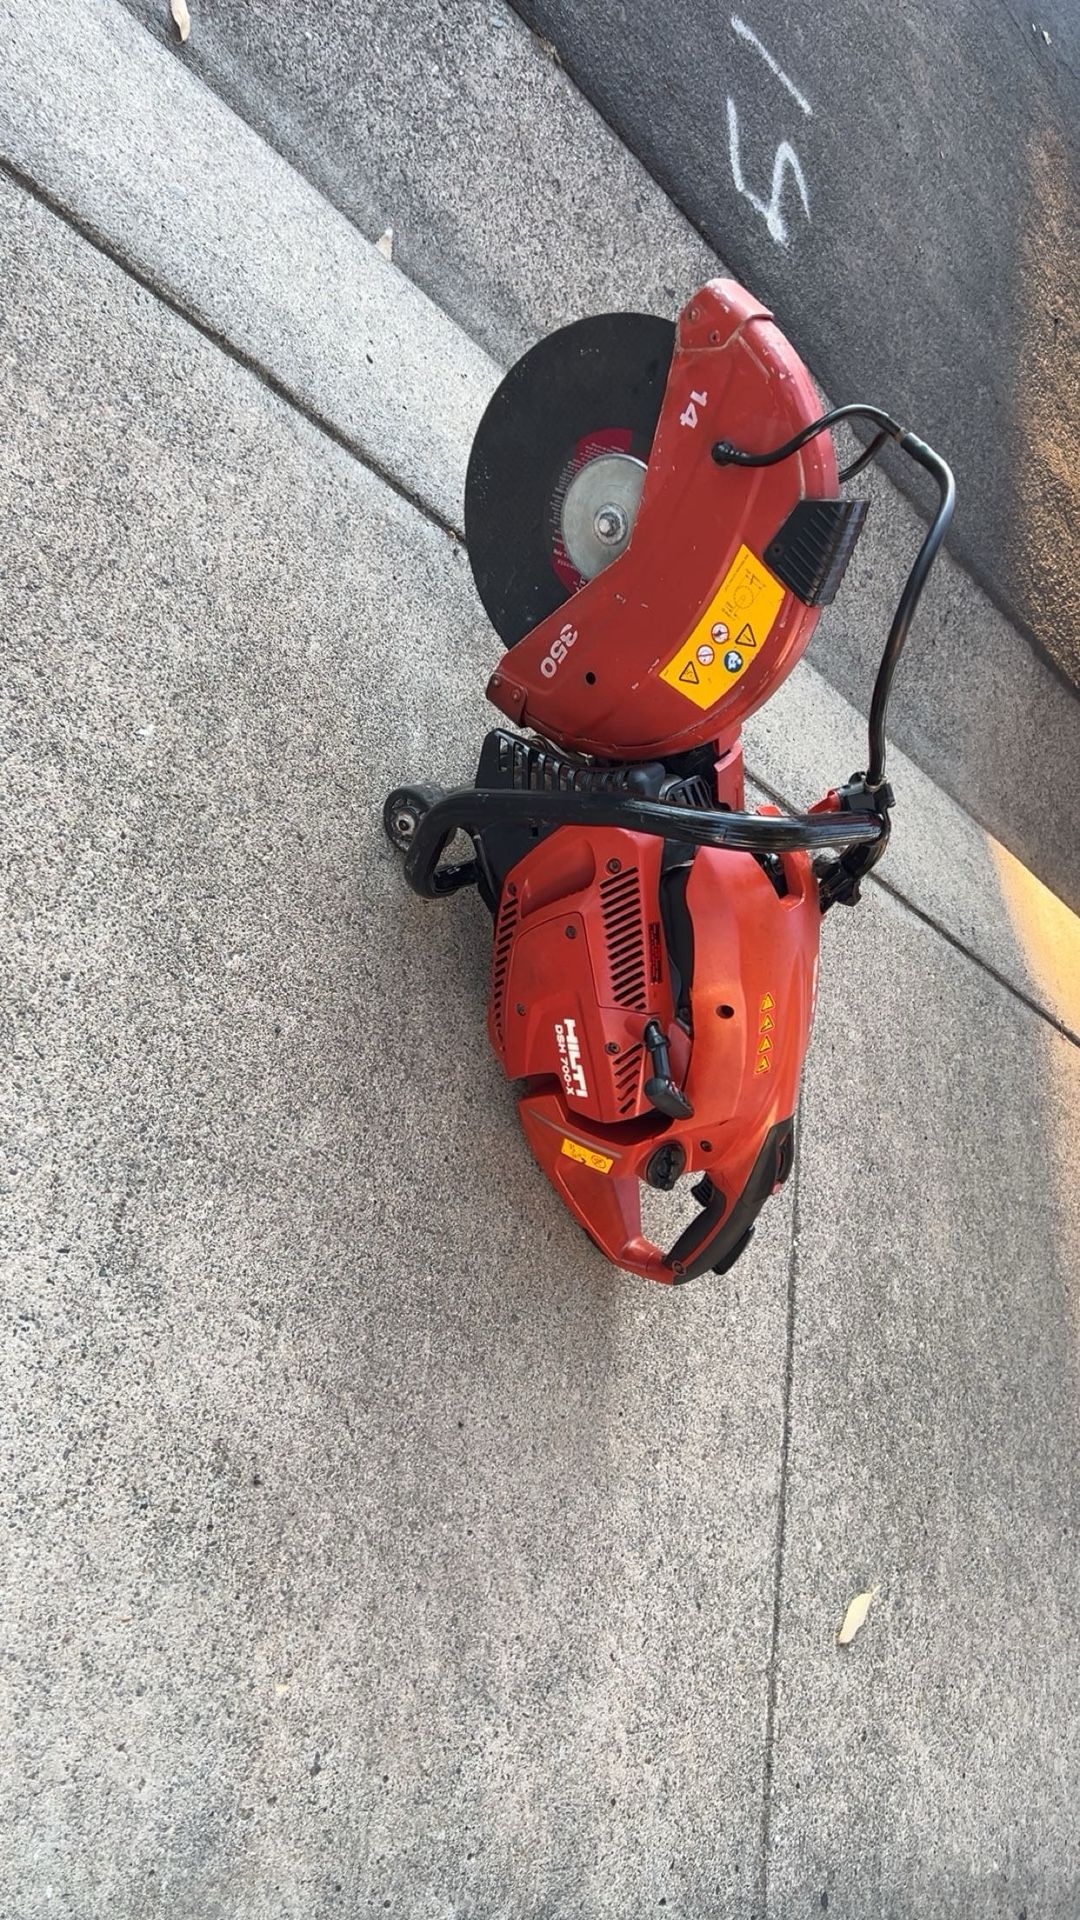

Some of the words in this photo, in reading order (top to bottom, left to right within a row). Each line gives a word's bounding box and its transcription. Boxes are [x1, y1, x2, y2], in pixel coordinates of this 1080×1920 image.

[680, 390, 707, 428] 14
[541, 624, 578, 678] 350
[555, 1024, 567, 1053] DSH
[561, 1057, 575, 1095] 700-X
[564, 1019, 588, 1097] HILTI
